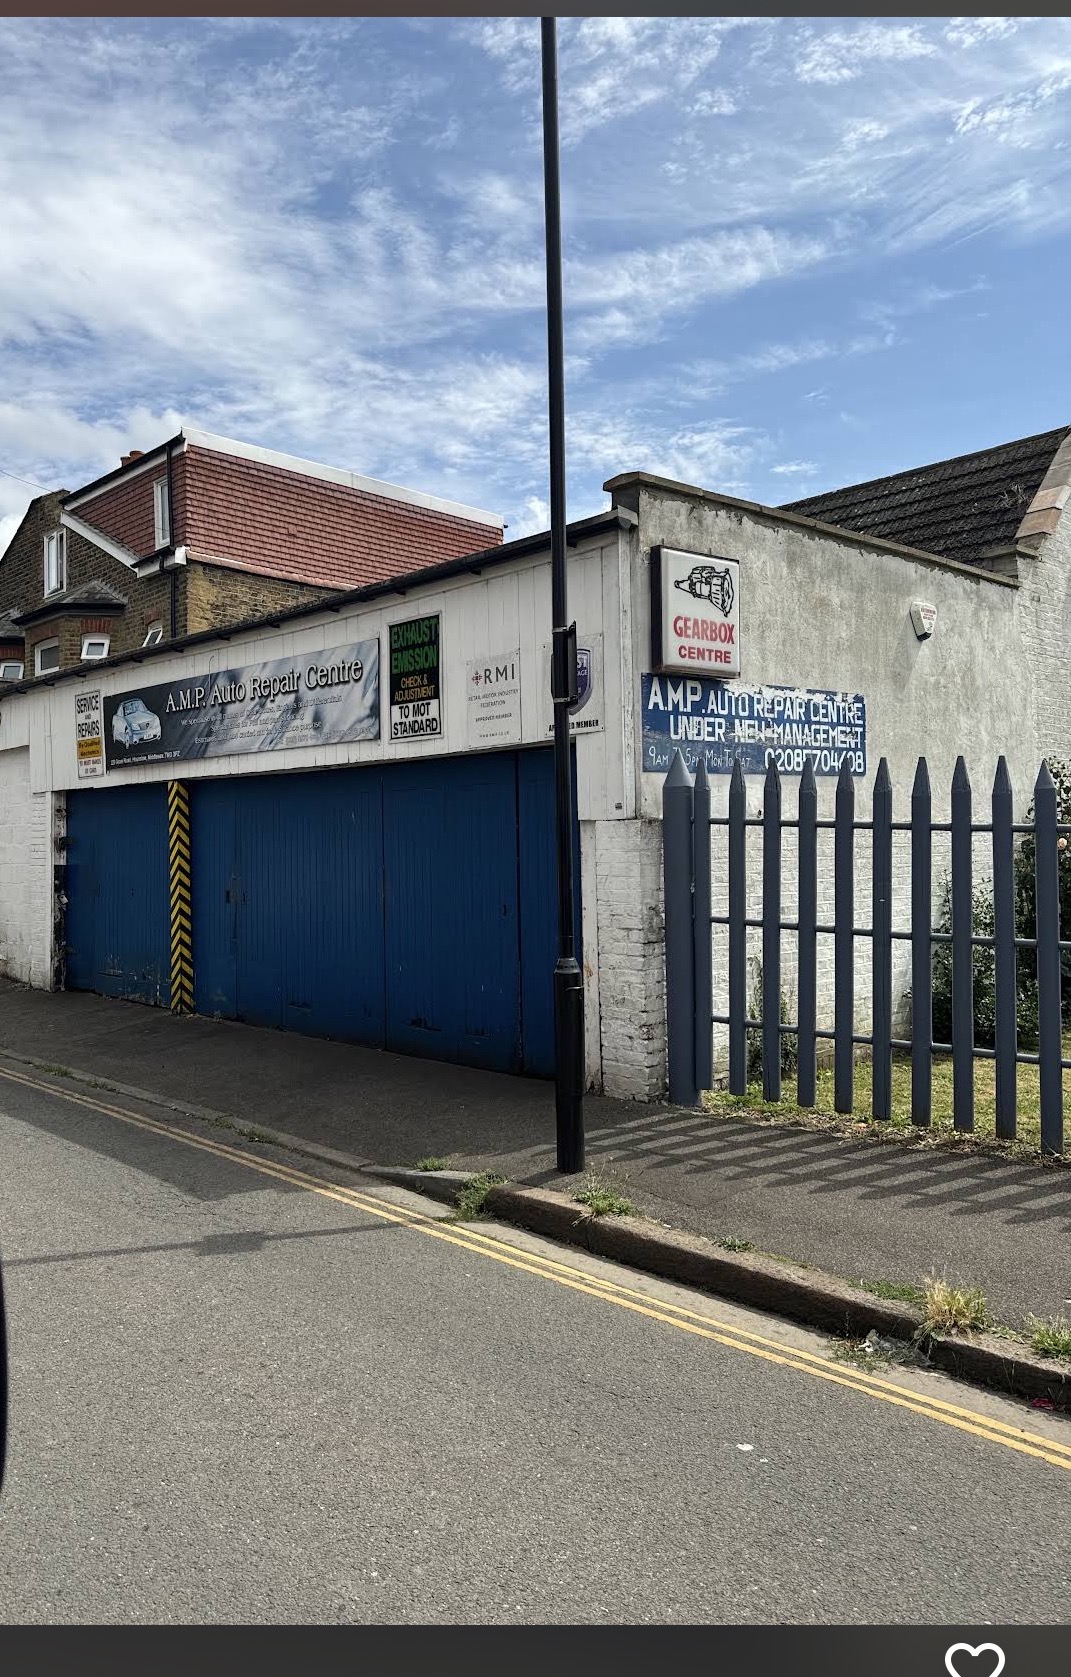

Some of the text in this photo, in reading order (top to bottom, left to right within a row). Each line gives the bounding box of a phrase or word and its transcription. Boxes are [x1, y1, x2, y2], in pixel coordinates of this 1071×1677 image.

[391, 618, 438, 650] EXHAUST
[673, 615, 735, 645] GEARBOX
[391, 645, 437, 674] EMISSION
[678, 645, 732, 664] CENTRE
[400, 673, 428, 689] CHECK &
[484, 663, 515, 685] RMI
[165, 659, 363, 713] A.M.P. Auto Repair Centre
[394, 685, 436, 702] ADJUSTMENT
[77, 695, 99, 714] SERVICE
[399, 702, 431, 719] TO MOT
[707, 689, 749, 717] AUTO
[754, 693, 806, 721] REPAIR
[810, 699, 864, 725] CENTRE
[78, 720, 99, 738] REPAIRS
[393, 717, 438, 737] STANDARD
[576, 719, 599, 729] MEMBER
[669, 715, 726, 742] UNDER
[774, 722, 864, 749] MANAGEMENT
